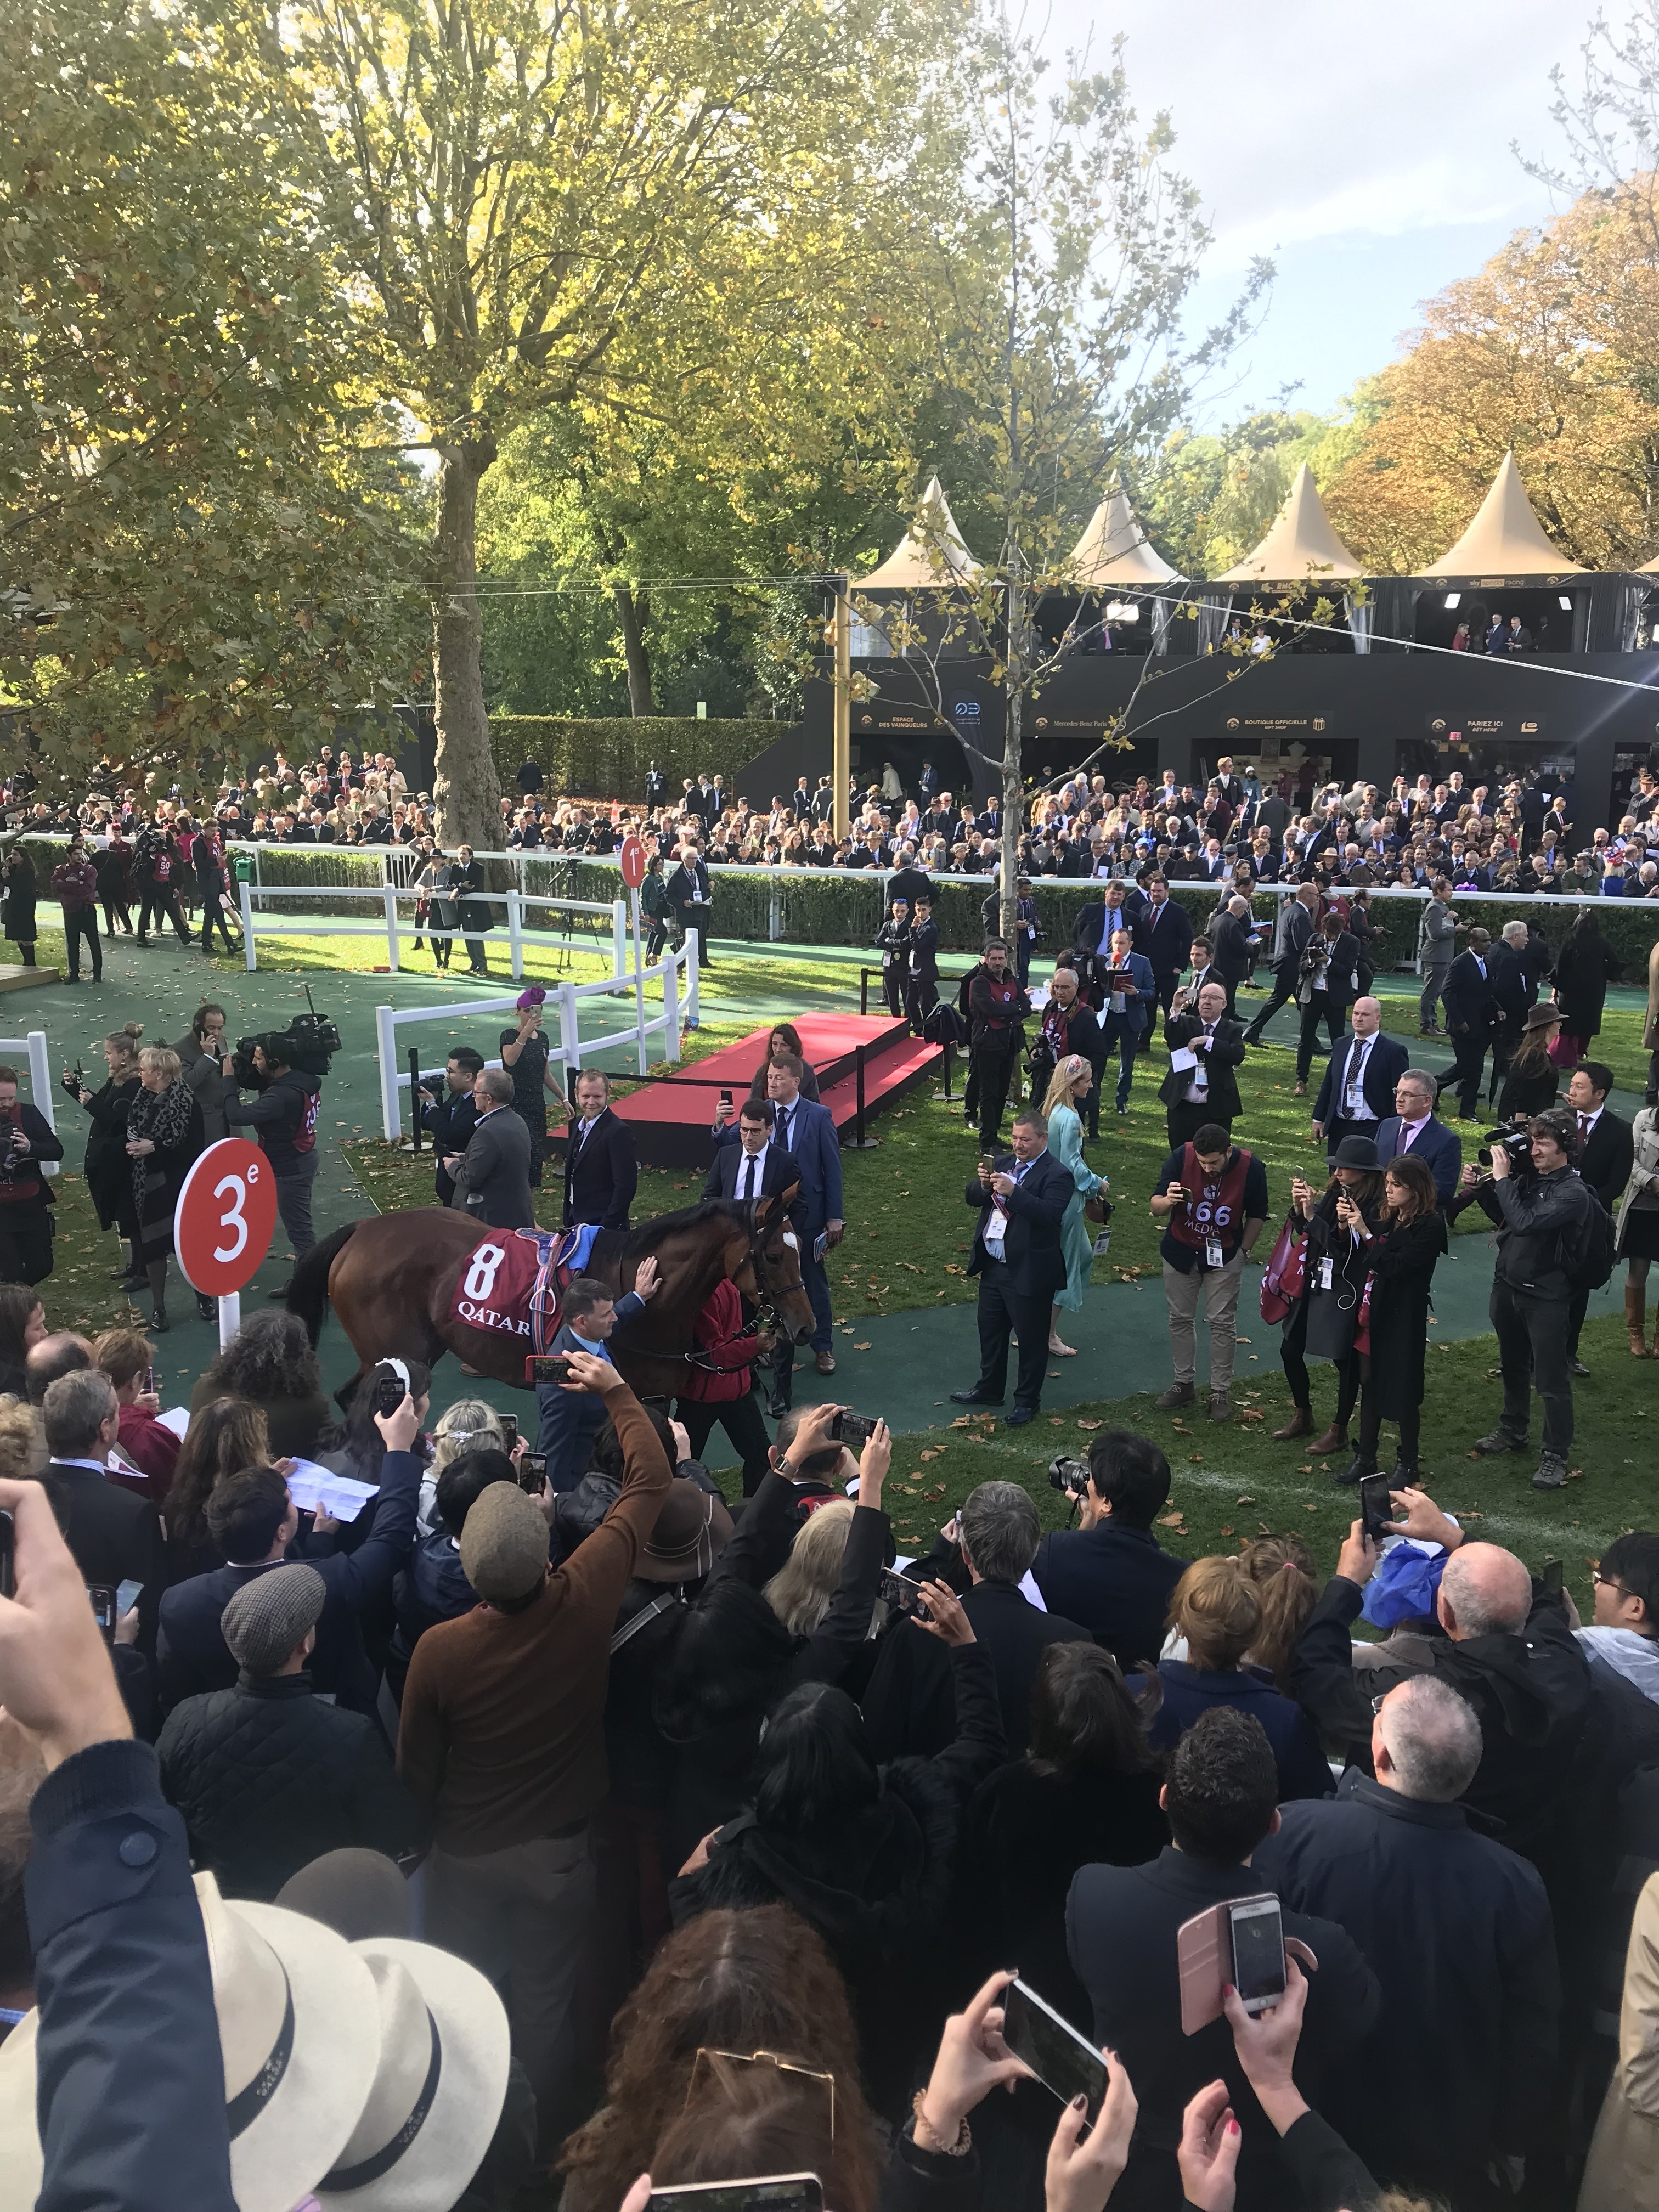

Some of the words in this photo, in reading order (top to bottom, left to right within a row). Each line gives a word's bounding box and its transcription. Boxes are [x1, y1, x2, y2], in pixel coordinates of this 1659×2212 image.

[160, 861, 170, 870] 50
[464, 1243, 505, 1301] 8
[458, 1301, 531, 1336] QATAR
